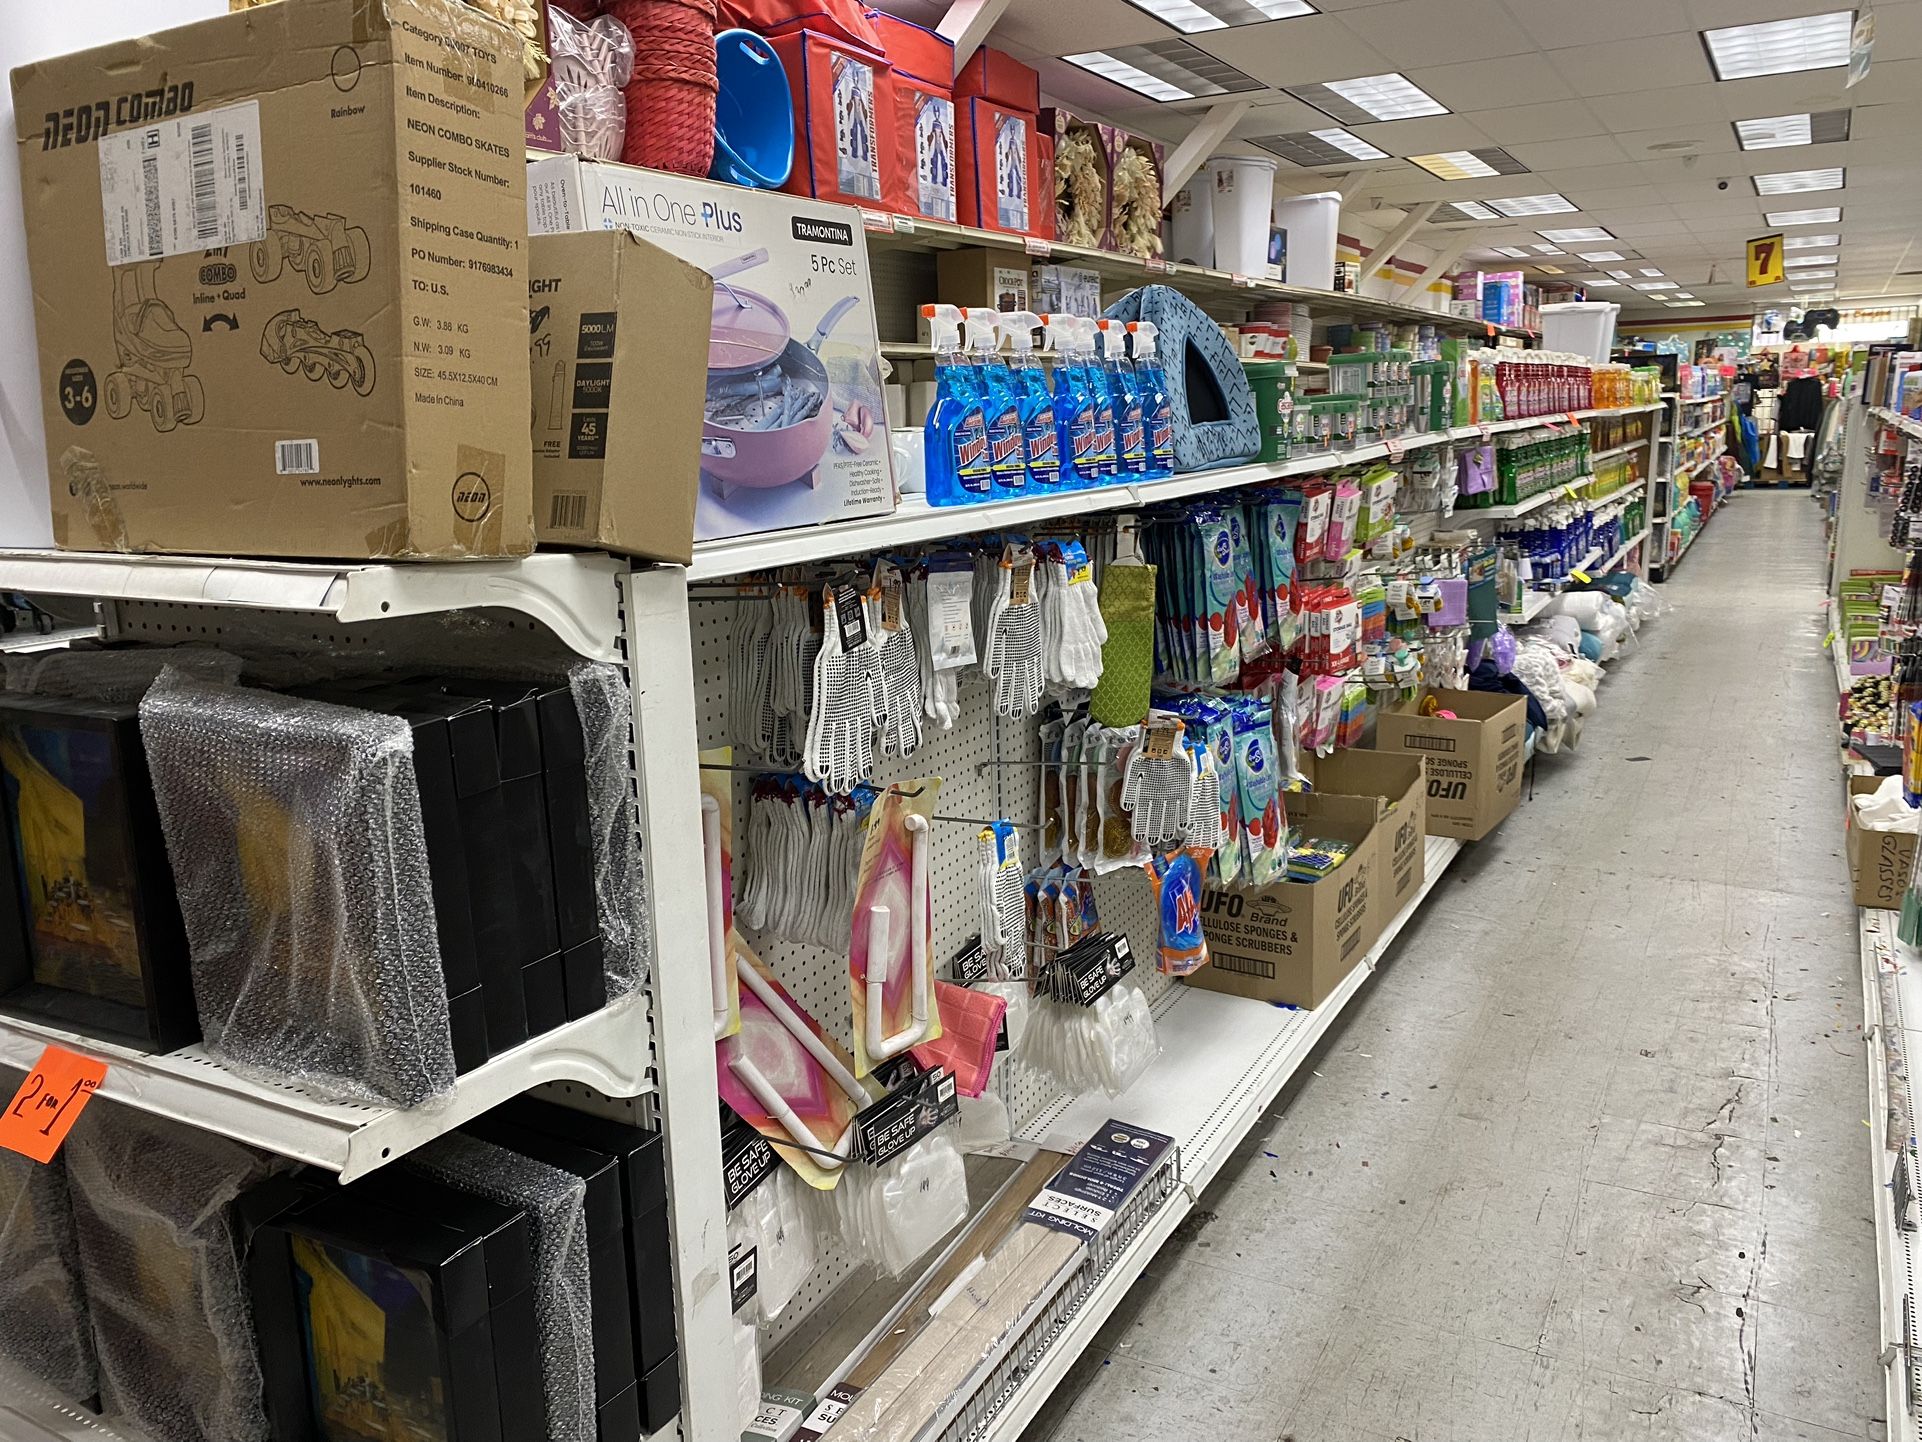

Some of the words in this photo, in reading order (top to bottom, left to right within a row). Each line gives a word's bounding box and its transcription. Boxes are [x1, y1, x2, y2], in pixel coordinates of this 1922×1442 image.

[402, 21, 444, 46] Category
[472, 46, 497, 64] TOYS
[404, 52, 425, 70] Item
[426, 60, 464, 83] Number:
[330, 104, 366, 119] Rainbow
[406, 85, 426, 102] Item
[428, 94, 480, 119] Description:
[407, 118, 436, 136] NEON
[437, 126, 473, 147] COMBO
[474, 138, 510, 158] SKATES
[867, 90, 878, 174] TRANSFORMERS
[408, 150, 447, 170] Supplier
[448, 161, 473, 178] Stock
[474, 170, 511, 188] Number:
[410, 183, 442, 200] 101460
[602, 186, 626, 216] All
[628, 188, 650, 218] in
[653, 193, 697, 226] One
[701, 201, 743, 233] Plus
[410, 216, 451, 237] Shipping
[452, 227, 474, 240] Case
[476, 230, 513, 250] Quantity:
[514, 240, 519, 250] 1
[796, 222, 849, 242] TRAMONTINA
[412, 248, 426, 260] PO
[428, 251, 466, 268] Number:
[468, 259, 514, 278] 9176983434
[810, 254, 819, 272] 5
[820, 256, 836, 274] Pc
[838, 257, 857, 276] Set
[1754, 242, 1775, 276] 7
[200, 265, 236, 284] COMBO
[192, 292, 216, 304] Inline
[222, 287, 246, 301] Quad
[412, 279, 430, 292] TO:
[430, 282, 449, 296] U.S.
[529, 278, 562, 294] IGHT
[457, 323, 469, 334] KG
[438, 344, 454, 356] 3.09
[459, 348, 470, 359] KG
[414, 366, 435, 380] SIZE:
[576, 379, 610, 387] DAYLIGHT
[64, 386, 92, 409] 3-6
[414, 392, 436, 404] Made
[444, 396, 464, 408] China
[581, 422, 597, 435] 45
[844, 498, 862, 506] Lifetime
[862, 496, 882, 504] Warranty
[1430, 768, 1472, 780] CELLULOSE
[1436, 758, 1468, 768] SPONGE
[1427, 780, 1467, 800] UFO
[1200, 889, 1244, 918] UFO
[1200, 916, 1240, 934] ELLULOSE
[1244, 924, 1288, 941] SPONGES
[1290, 932, 1298, 943] &
[1250, 912, 1288, 927] Brand
[1204, 930, 1233, 946] PONGE
[1235, 938, 1293, 956] SCRUBBERS
[962, 959, 974, 972] BE
[973, 950, 988, 966] SA
[1080, 977, 1089, 990] BE
[1088, 966, 1104, 983] SAFE
[1082, 982, 1100, 998] GLOVE
[1098, 976, 1107, 988] UP
[932, 1070, 942, 1082] 50
[12, 1074, 44, 1118] 2
[878, 1130, 891, 1146] BE
[891, 1113, 915, 1137] SAFE
[878, 1135, 904, 1157] GLOVE
[904, 1126, 916, 1140] UP
[728, 1161, 742, 1183] BE
[742, 1140, 769, 1170] SAFE
[731, 1165, 760, 1194] GLOVE
[758, 1152, 772, 1172] UP
[1028, 1210, 1048, 1221] KIT
[1048, 1214, 1094, 1236] MOLDING
[784, 1396, 804, 1406] KIT
